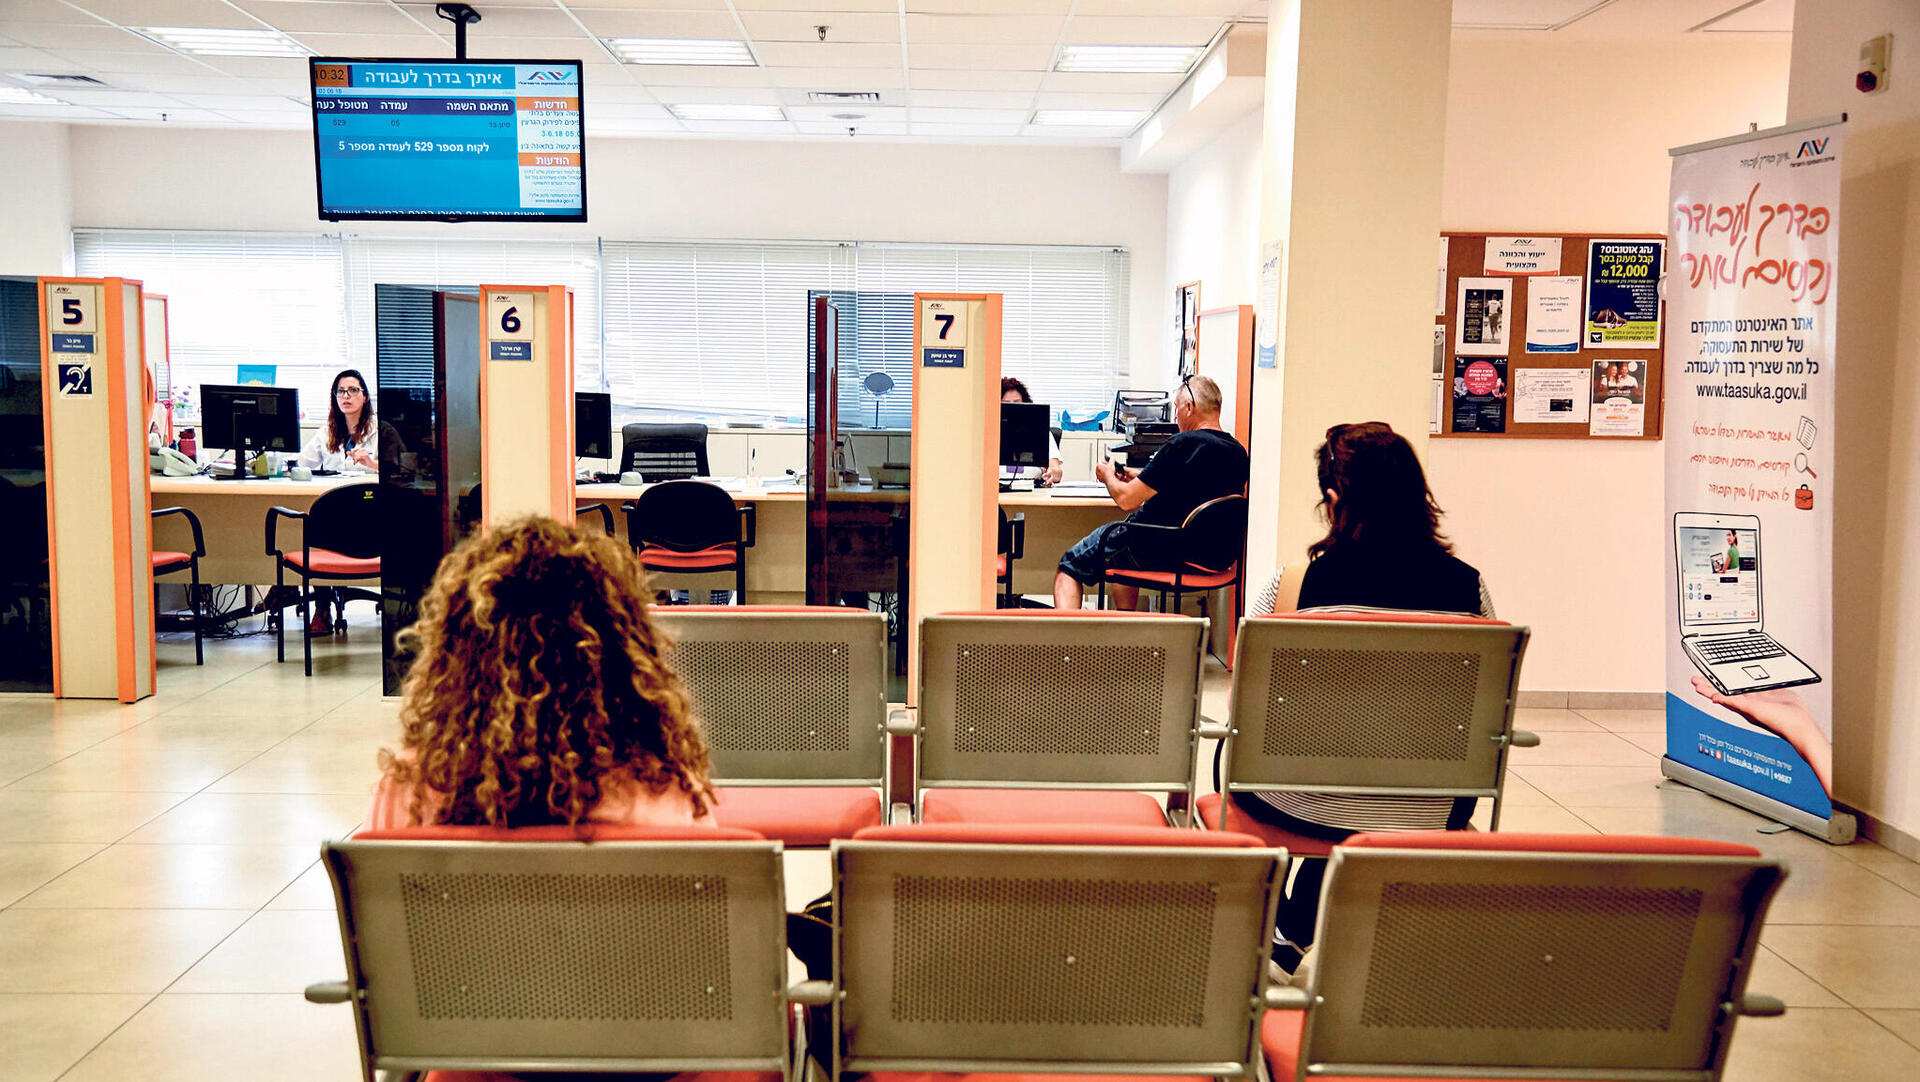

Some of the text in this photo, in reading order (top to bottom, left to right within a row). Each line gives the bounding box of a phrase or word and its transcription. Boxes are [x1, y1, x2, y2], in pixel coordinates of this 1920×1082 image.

[365, 69, 502, 87] איתך בדרך לעבודה
[337, 99, 369, 110] מטופל
[380, 101, 408, 111] עמדה
[446, 102, 509, 111] מתאם השמה
[533, 100, 568, 109] חדשות
[332, 119, 347, 127] 529
[338, 140, 490, 154] לקוח מספר 529 לעמדה מספר 5
[1675, 182, 1830, 257] בדרך לעבודה
[1499, 250, 1546, 259] ייעוץ והכוונה
[1600, 245, 1654, 254] נהג אוטובוס?
[1599, 254, 1654, 265] קבל מענק בסך
[1610, 264, 1648, 278] 12,000
[1681, 235, 1831, 305] נכנסים לאתר
[62, 298, 83, 325] 5
[501, 306, 521, 333] 6
[934, 314, 955, 340] 7
[1691, 317, 1813, 336] אתר האינטרנט המתקדם
[1700, 336, 1804, 356] של שירות התעסוקה,
[1684, 358, 1820, 378] כל מה שצריך בדרך לעבודה.
[1696, 382, 1808, 403] www.taasuka.gov.il
